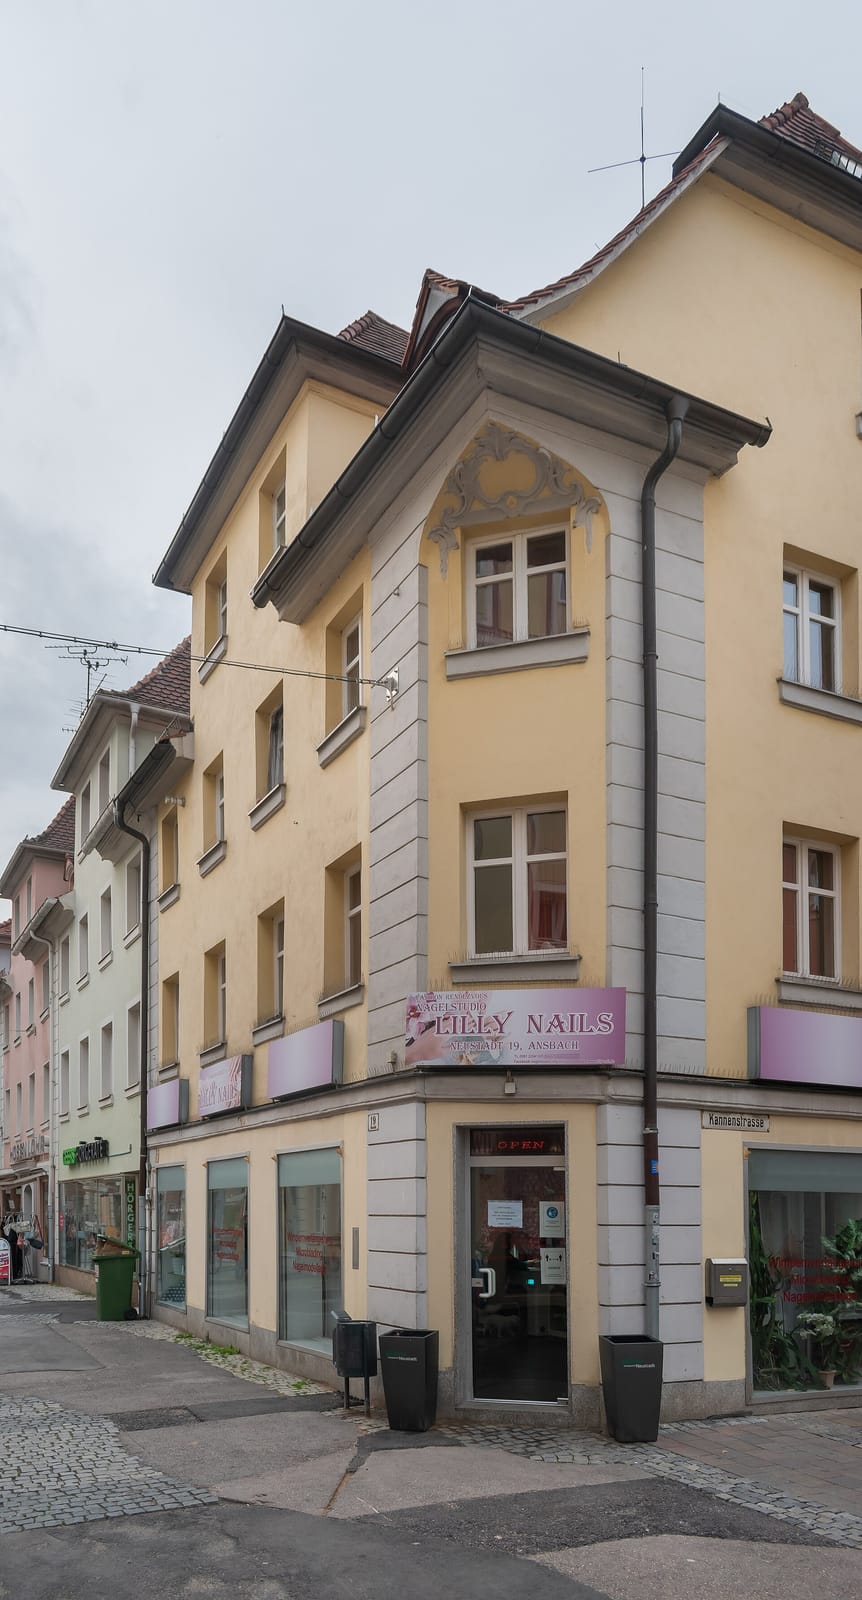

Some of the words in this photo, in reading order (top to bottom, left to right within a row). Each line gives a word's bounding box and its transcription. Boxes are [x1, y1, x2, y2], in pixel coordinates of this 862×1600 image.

[445, 991, 488, 1001] RENDEZVOUS
[416, 1002, 487, 1012] NAGELSTUDIO
[435, 1011, 514, 1035] LILLY
[527, 1012, 614, 1034] NAILS
[450, 1041, 503, 1051] NEUSTADT
[509, 1042, 523, 1051] 19,
[528, 1041, 579, 1050] ANSBACH
[709, 1113, 764, 1127] Kannenstrasse
[497, 1140, 545, 1150] OPEN
